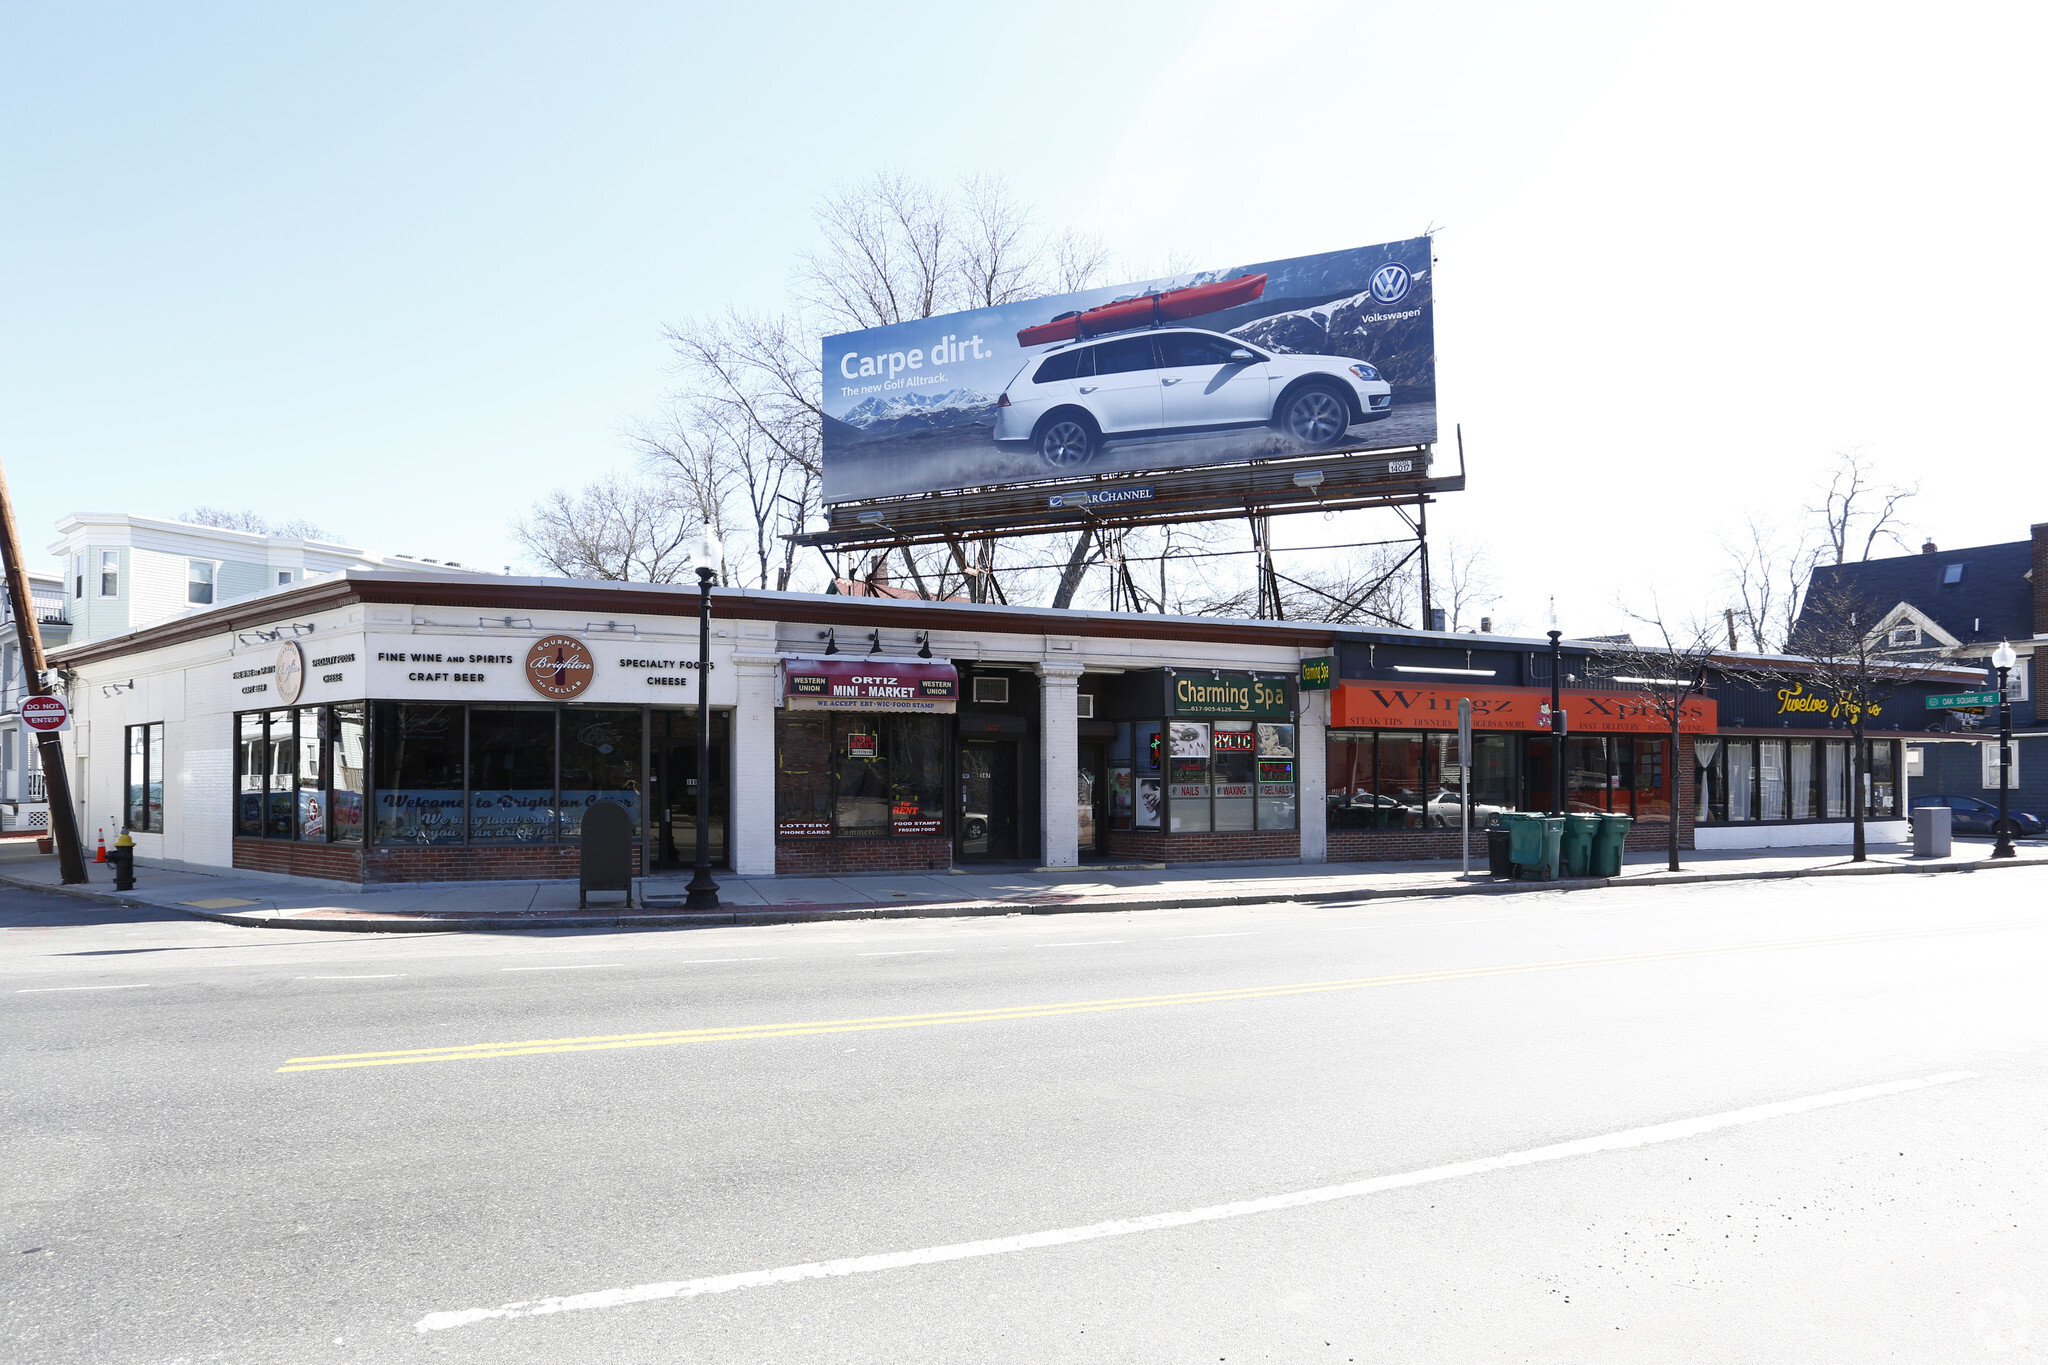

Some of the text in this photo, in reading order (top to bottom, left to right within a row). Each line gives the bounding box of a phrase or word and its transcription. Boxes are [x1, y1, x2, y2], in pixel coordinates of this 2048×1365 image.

[1361, 308, 1421, 323] Volkswagen
[840, 334, 993, 380] Carpe dirt.
[841, 372, 948, 397] The new Golf Alltrack.
[537, 639, 582, 652] GOURMET
[378, 652, 406, 661] FINE
[410, 653, 442, 662] WINE
[469, 655, 513, 664] SPIRITS
[529, 654, 592, 679] Brighton
[619, 659, 715, 670] SPECIALTY FOOS
[408, 672, 485, 682] CRAFT BEER
[1302, 662, 1329, 684] Charming Spa
[646, 677, 687, 686] CHEESE
[851, 676, 898, 685] ORTIZ
[921, 680, 952, 688] WESTERN
[536, 679, 582, 694] AND CELLAR
[833, 685, 859, 697] MINI
[868, 686, 915, 698] MARKET
[1177, 680, 1284, 710] Charming Spa
[1777, 682, 1828, 714] Twelve
[1956, 696, 1979, 704] SQUARE
[1982, 695, 1994, 703] AVE
[1350, 717, 1380, 725] STEAK
[1382, 717, 1403, 726] TIPS
[1414, 718, 1452, 726] DINNERS
[1505, 720, 1527, 728] MORE
[1579, 722, 1597, 730] FAST
[1602, 722, 1640, 731] DELIVERY
[851, 741, 876, 749] RENT
[1181, 786, 1199, 796] NAILS
[1223, 786, 1247, 795] WAXING
[1264, 785, 1290, 795] GEL NAILS
[384, 794, 466, 809] Welcome
[476, 797, 494, 809] to
[892, 806, 919, 815] RENT
[421, 813, 448, 825] We
[487, 814, 522, 826] local
[431, 828, 458, 839] you
